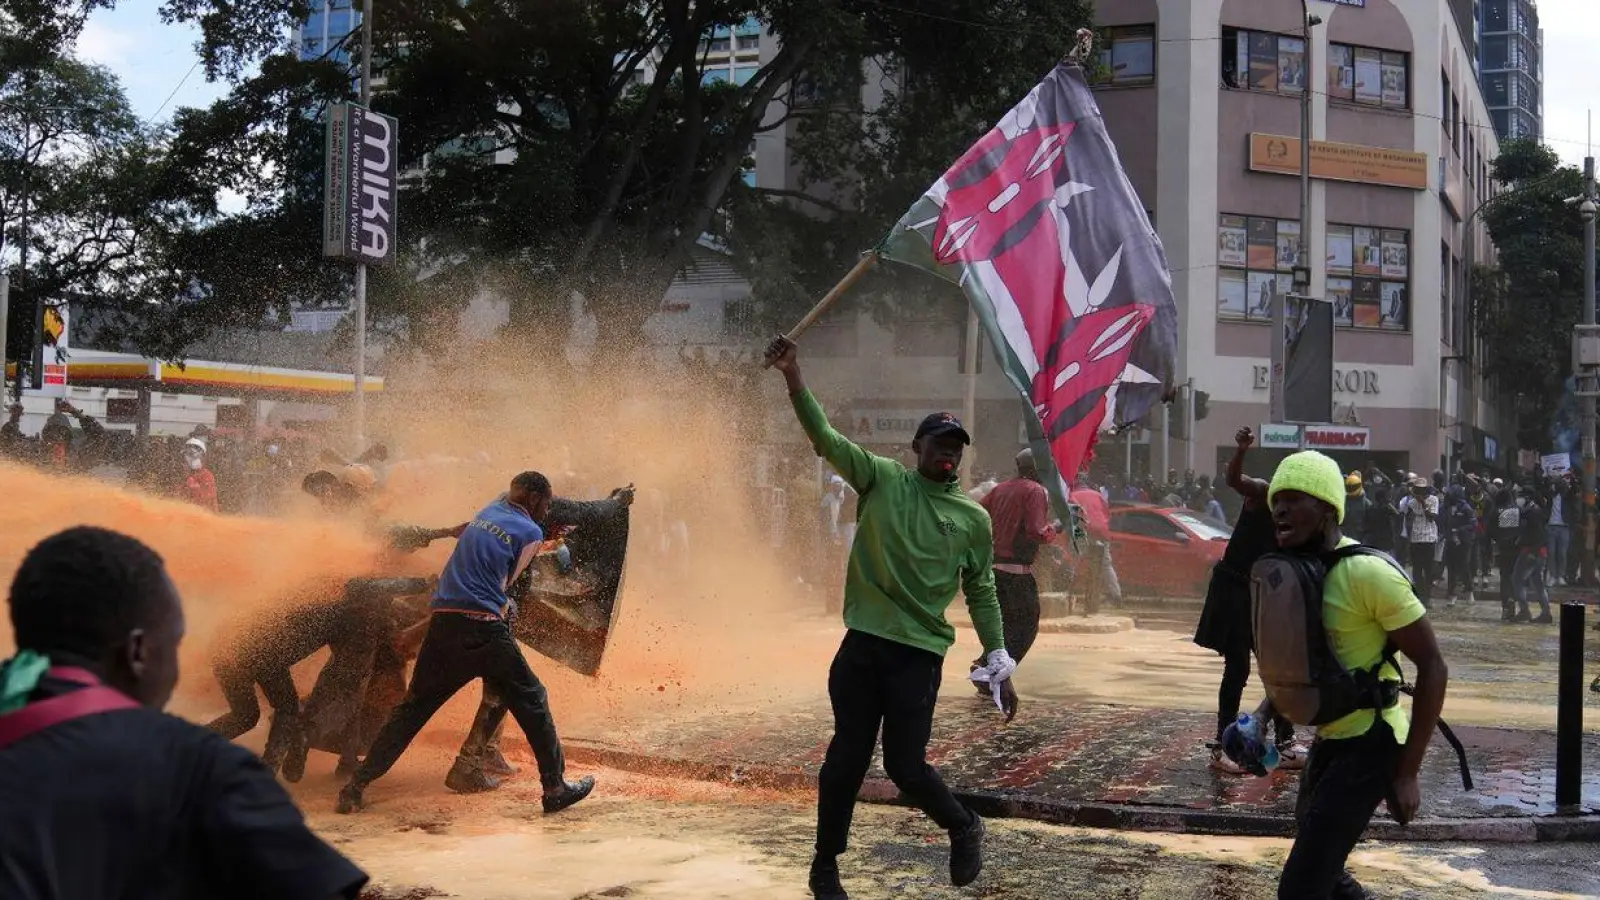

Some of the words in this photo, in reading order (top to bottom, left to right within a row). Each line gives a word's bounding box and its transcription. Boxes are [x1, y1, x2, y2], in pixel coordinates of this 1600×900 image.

[354, 128, 359, 138] a
[1317, 145, 1339, 154] KENYA
[1340, 148, 1372, 158] INSTITUTE
[1383, 153, 1426, 164] MANAGEMENT
[351, 142, 360, 209] Wonderful
[362, 111, 391, 258] MIKA
[350, 213, 359, 252] World
[1253, 365, 1379, 394] EROR
